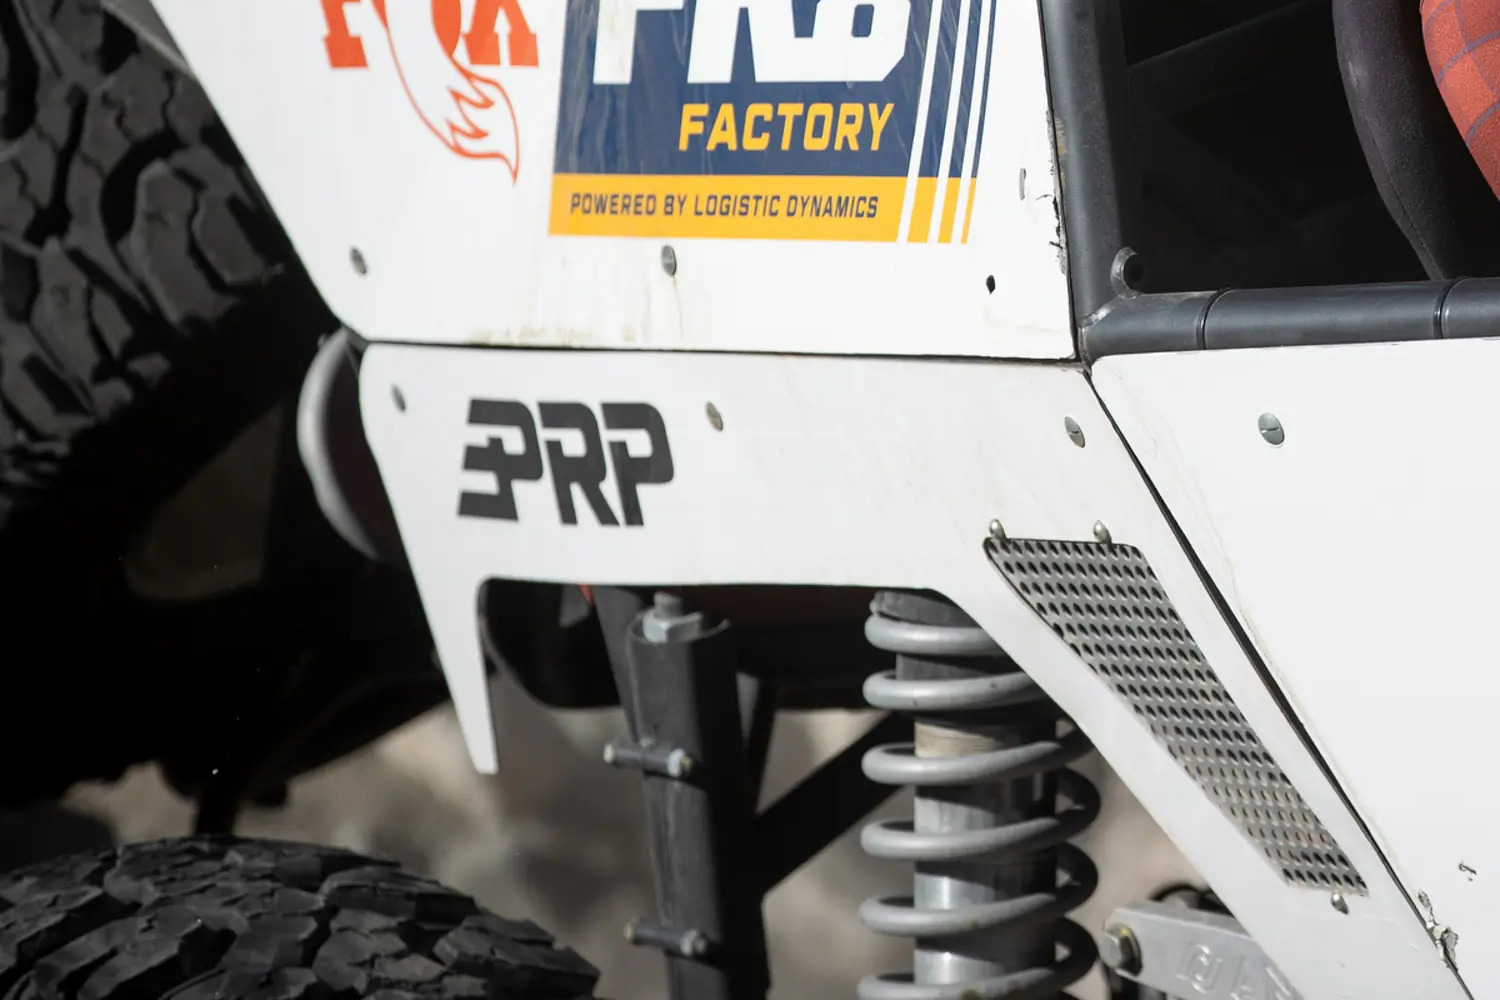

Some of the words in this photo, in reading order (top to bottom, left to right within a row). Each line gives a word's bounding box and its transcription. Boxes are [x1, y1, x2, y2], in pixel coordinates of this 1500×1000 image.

[678, 102, 895, 152] FACTORY
[570, 192, 657, 216] POWERED
[663, 193, 688, 217] BY
[693, 194, 781, 218] LOGISTIC
[785, 195, 880, 219] DYNAMICS
[458, 397, 675, 527] PRP
